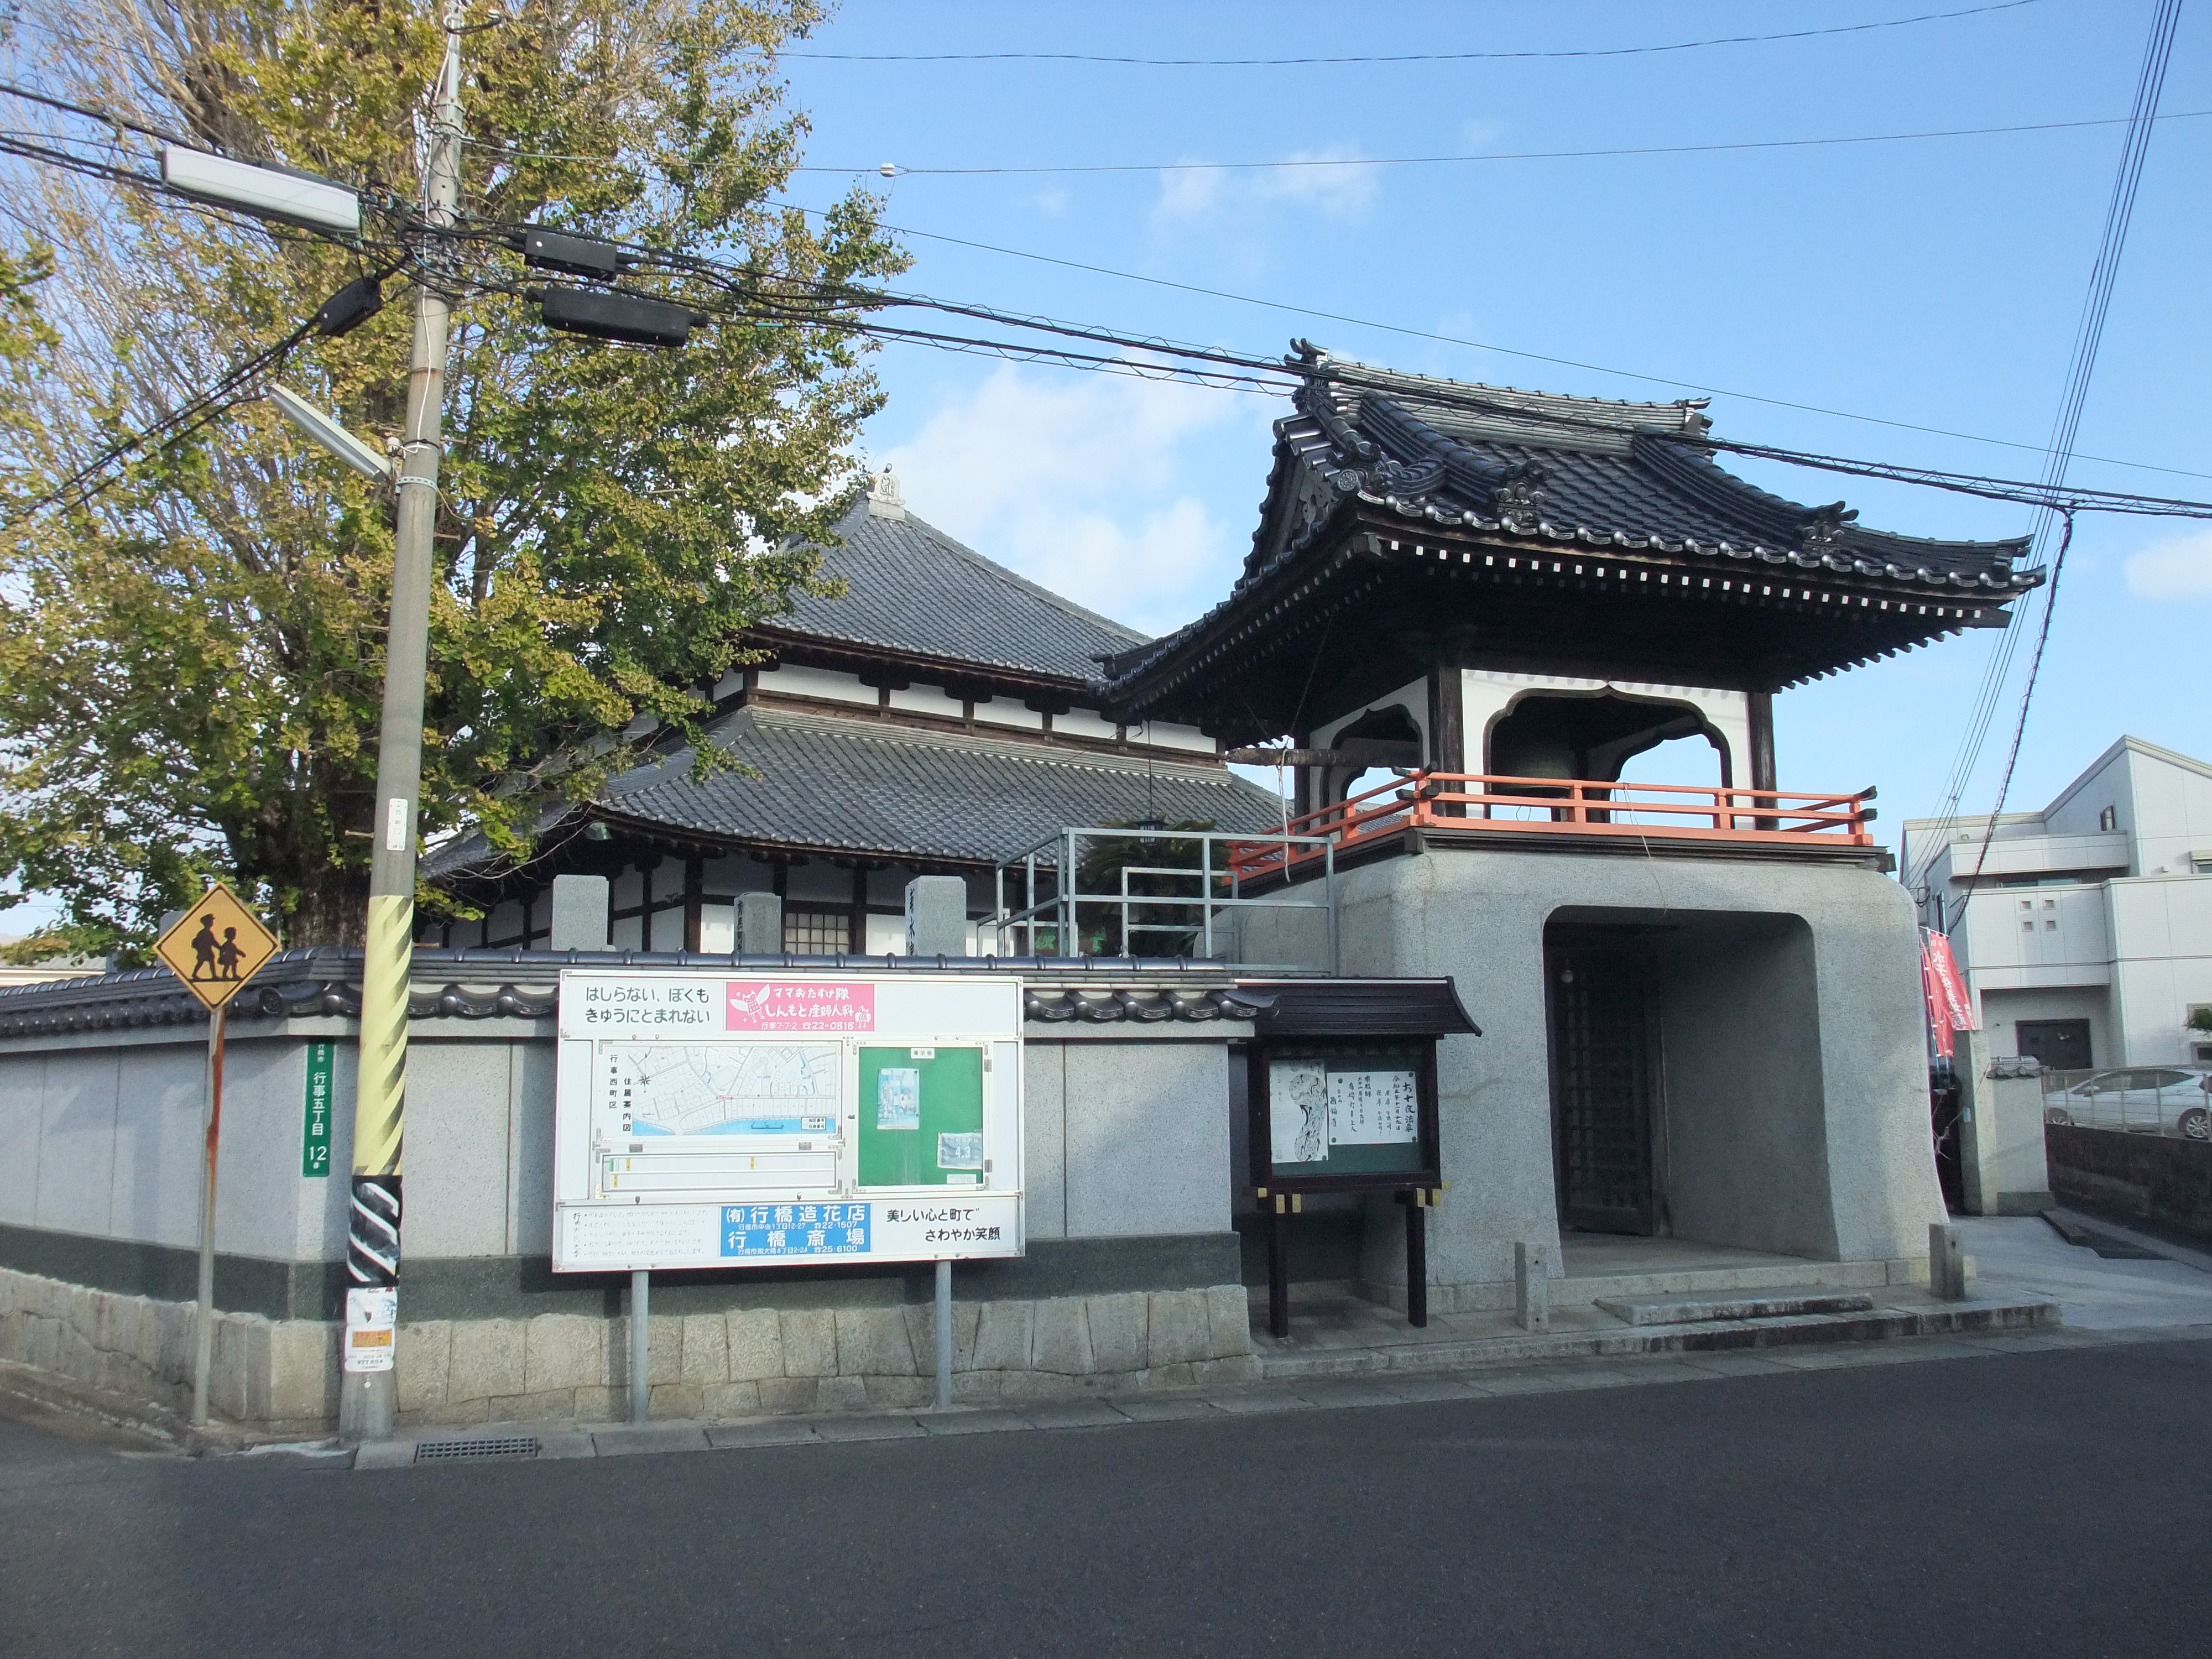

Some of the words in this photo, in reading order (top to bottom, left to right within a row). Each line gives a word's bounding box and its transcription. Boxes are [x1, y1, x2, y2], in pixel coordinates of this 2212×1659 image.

[586, 987, 709, 1003] はしらない、ぼくも
[773, 987, 849, 1001] ママおたすけ隊
[585, 1008, 711, 1024] きゅうにとまれない
[765, 1004, 854, 1018] しんもと産婦人科
[609, 1054, 618, 1109] 行事西町区
[312, 1072, 327, 1136] 行事五丁目
[309, 1145, 327, 1161] 12
[886, 1208, 980, 1222] 美しい心と町で
[925, 1227, 1000, 1241] さわやか笑顔
